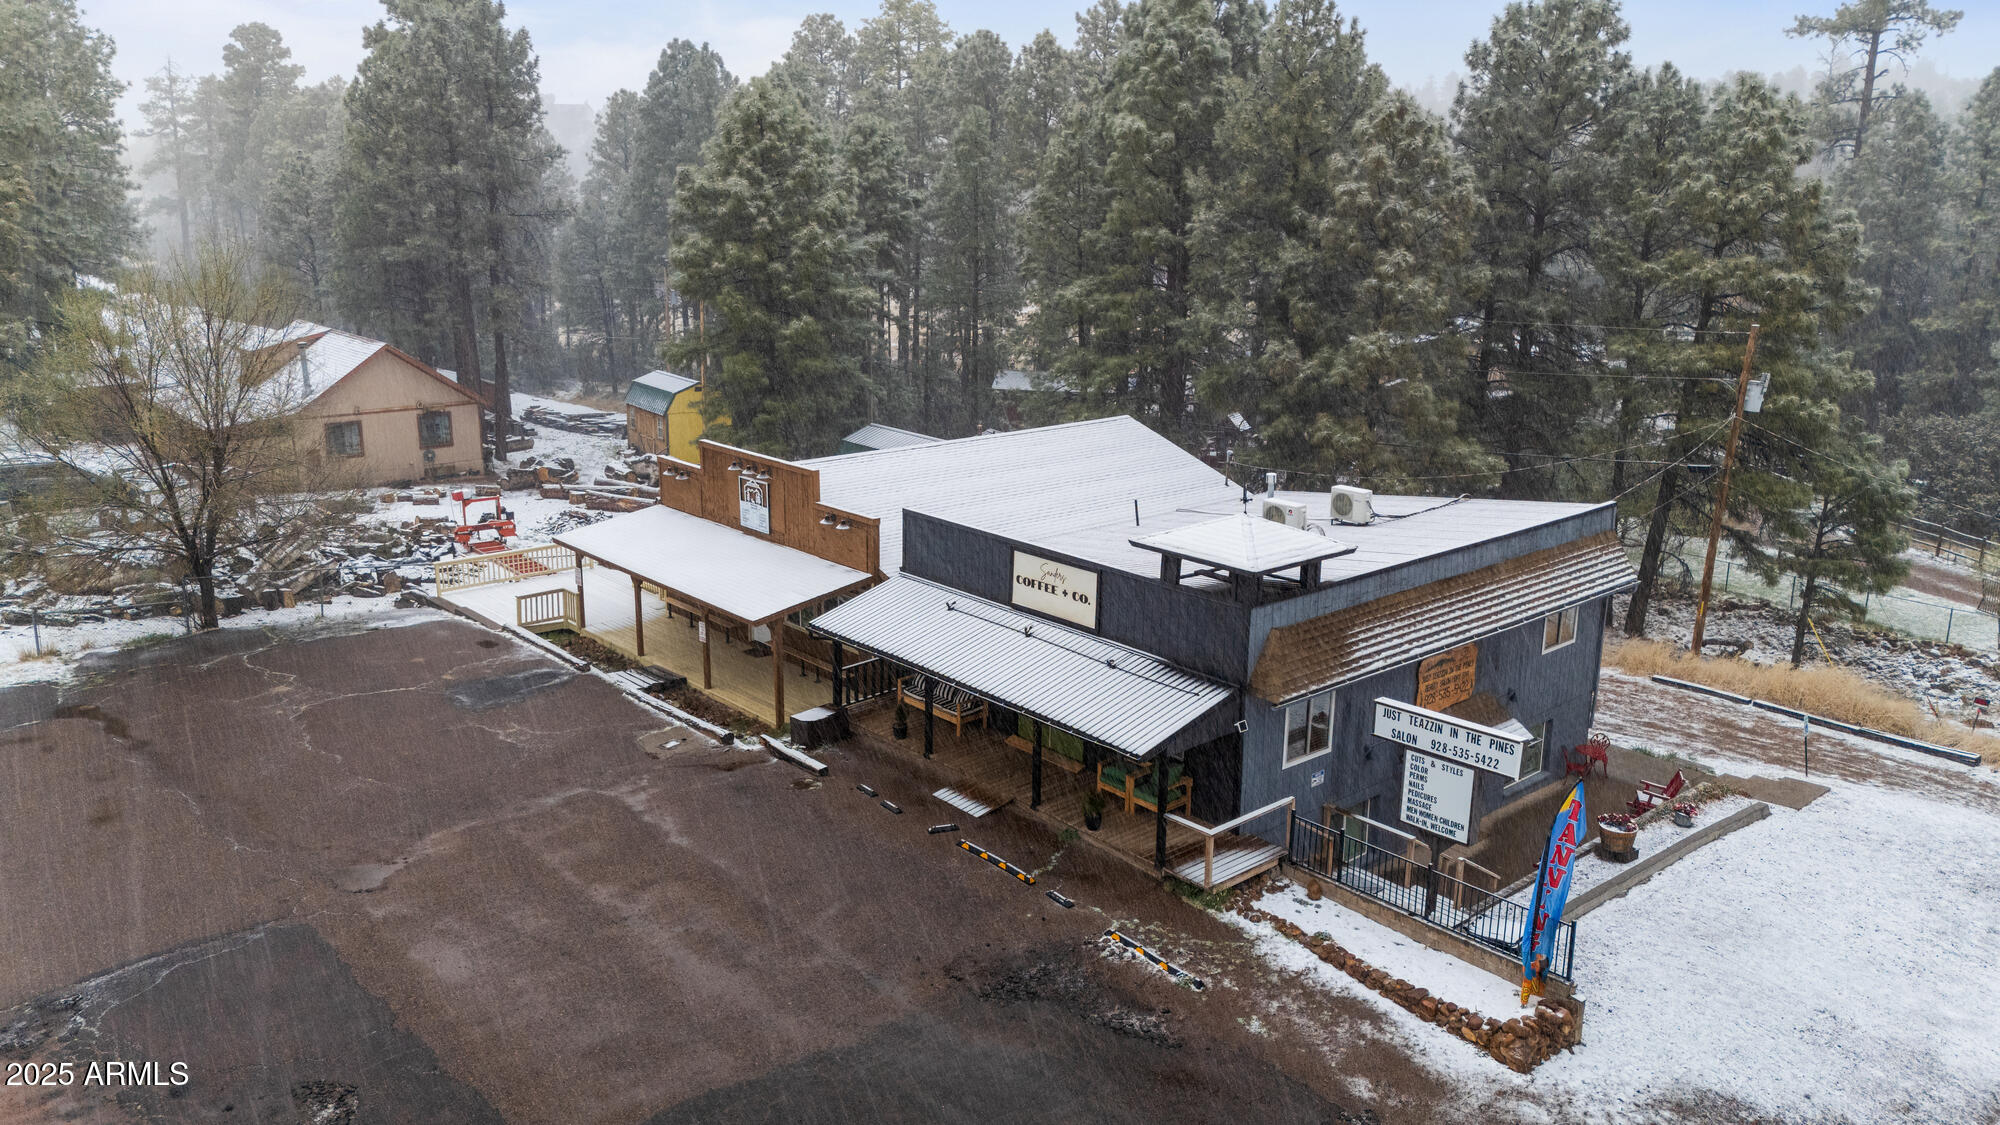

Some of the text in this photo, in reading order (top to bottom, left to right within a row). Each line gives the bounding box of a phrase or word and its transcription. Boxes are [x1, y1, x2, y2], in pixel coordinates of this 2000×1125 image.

[1016, 574, 1058, 595] COFFEE
[1072, 591, 1091, 606] CO.
[1382, 707, 1516, 756] JUST TEAZZIN IN THE PINES
[1391, 728, 1500, 770] SALON 928-535-5422
[1409, 762, 1429, 775] COLOR
[1409, 771, 1428, 783] PERMS
[1410, 754, 1464, 777] CUTS & STYLES
[1408, 780, 1425, 791] NAILS
[1408, 788, 1438, 804] PEDICURES
[1407, 796, 1432, 812] MASSAGE
[1405, 813, 1457, 838] WALK-IN, WELCOME
[1406, 805, 1465, 832] MEN WOMEN CHILDREN
[1531, 798, 1583, 951] TANNN
